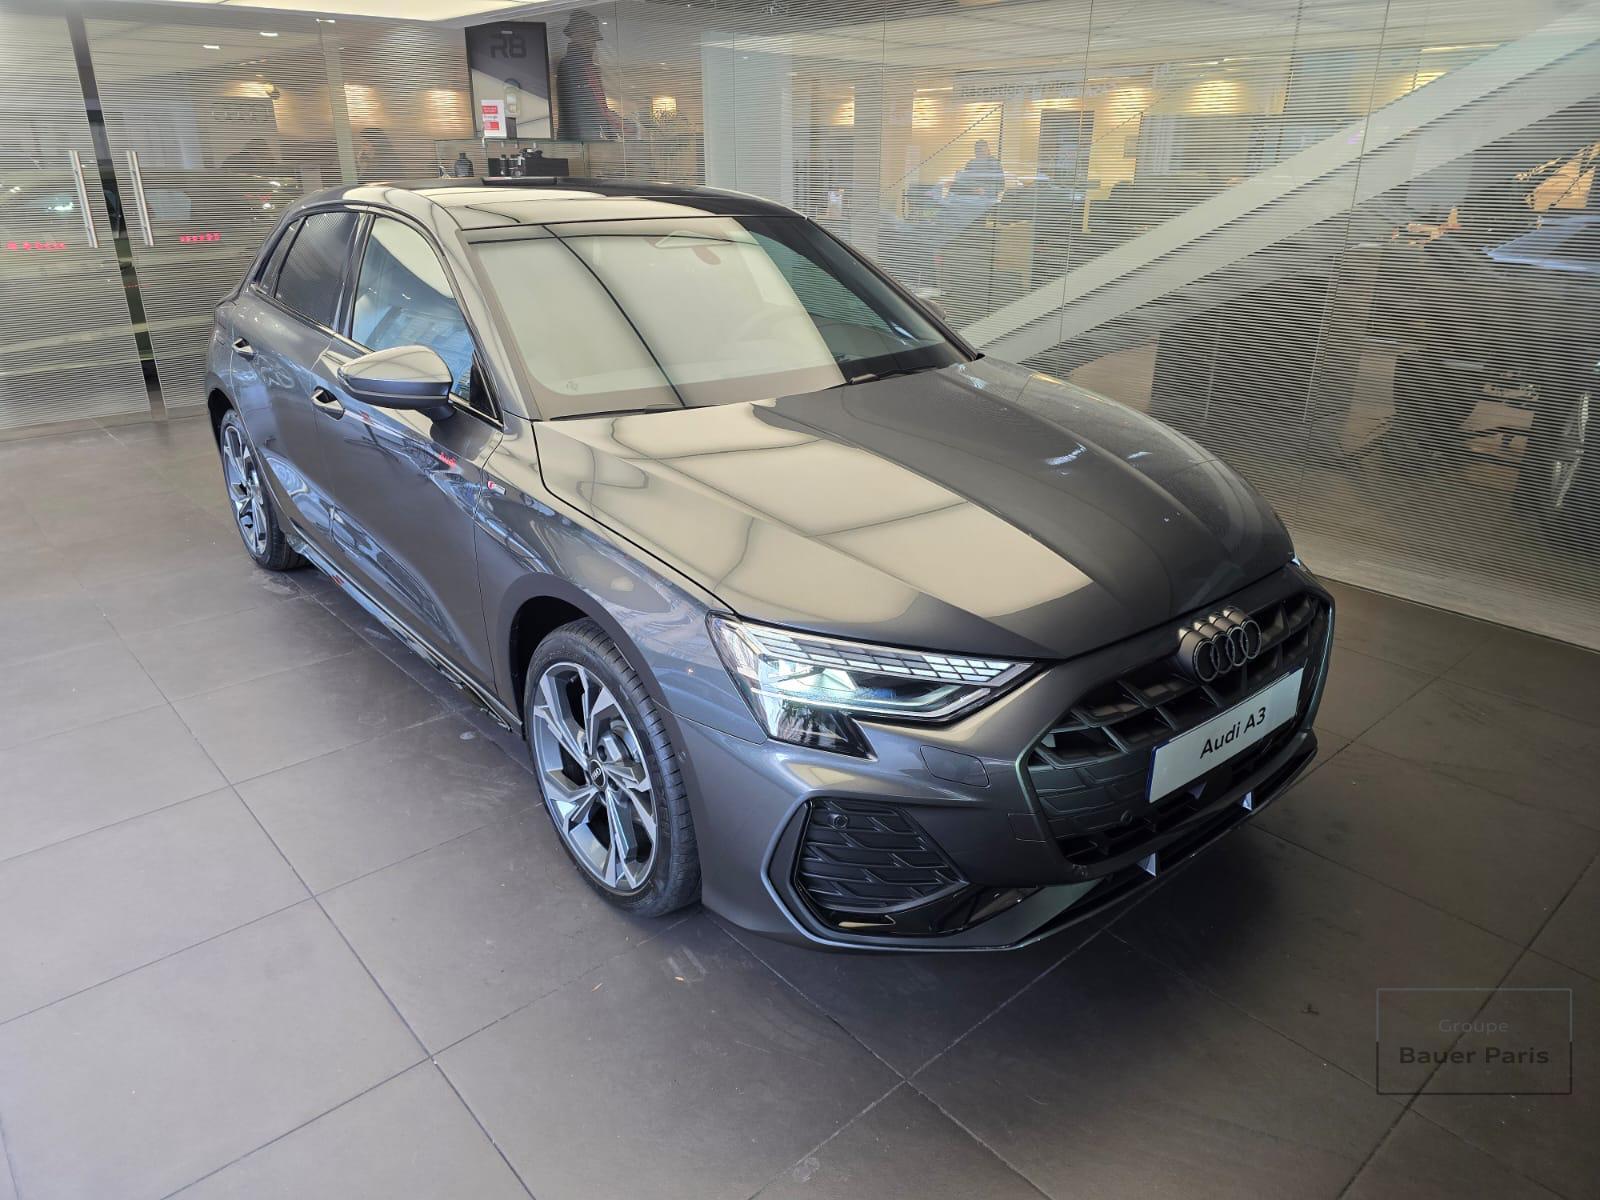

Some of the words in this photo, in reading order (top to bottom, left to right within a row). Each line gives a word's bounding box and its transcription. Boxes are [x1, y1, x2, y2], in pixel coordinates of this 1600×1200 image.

[490, 35, 527, 58] R8
[1200, 721, 1241, 759] Audi
[1244, 706, 1266, 734] A3
